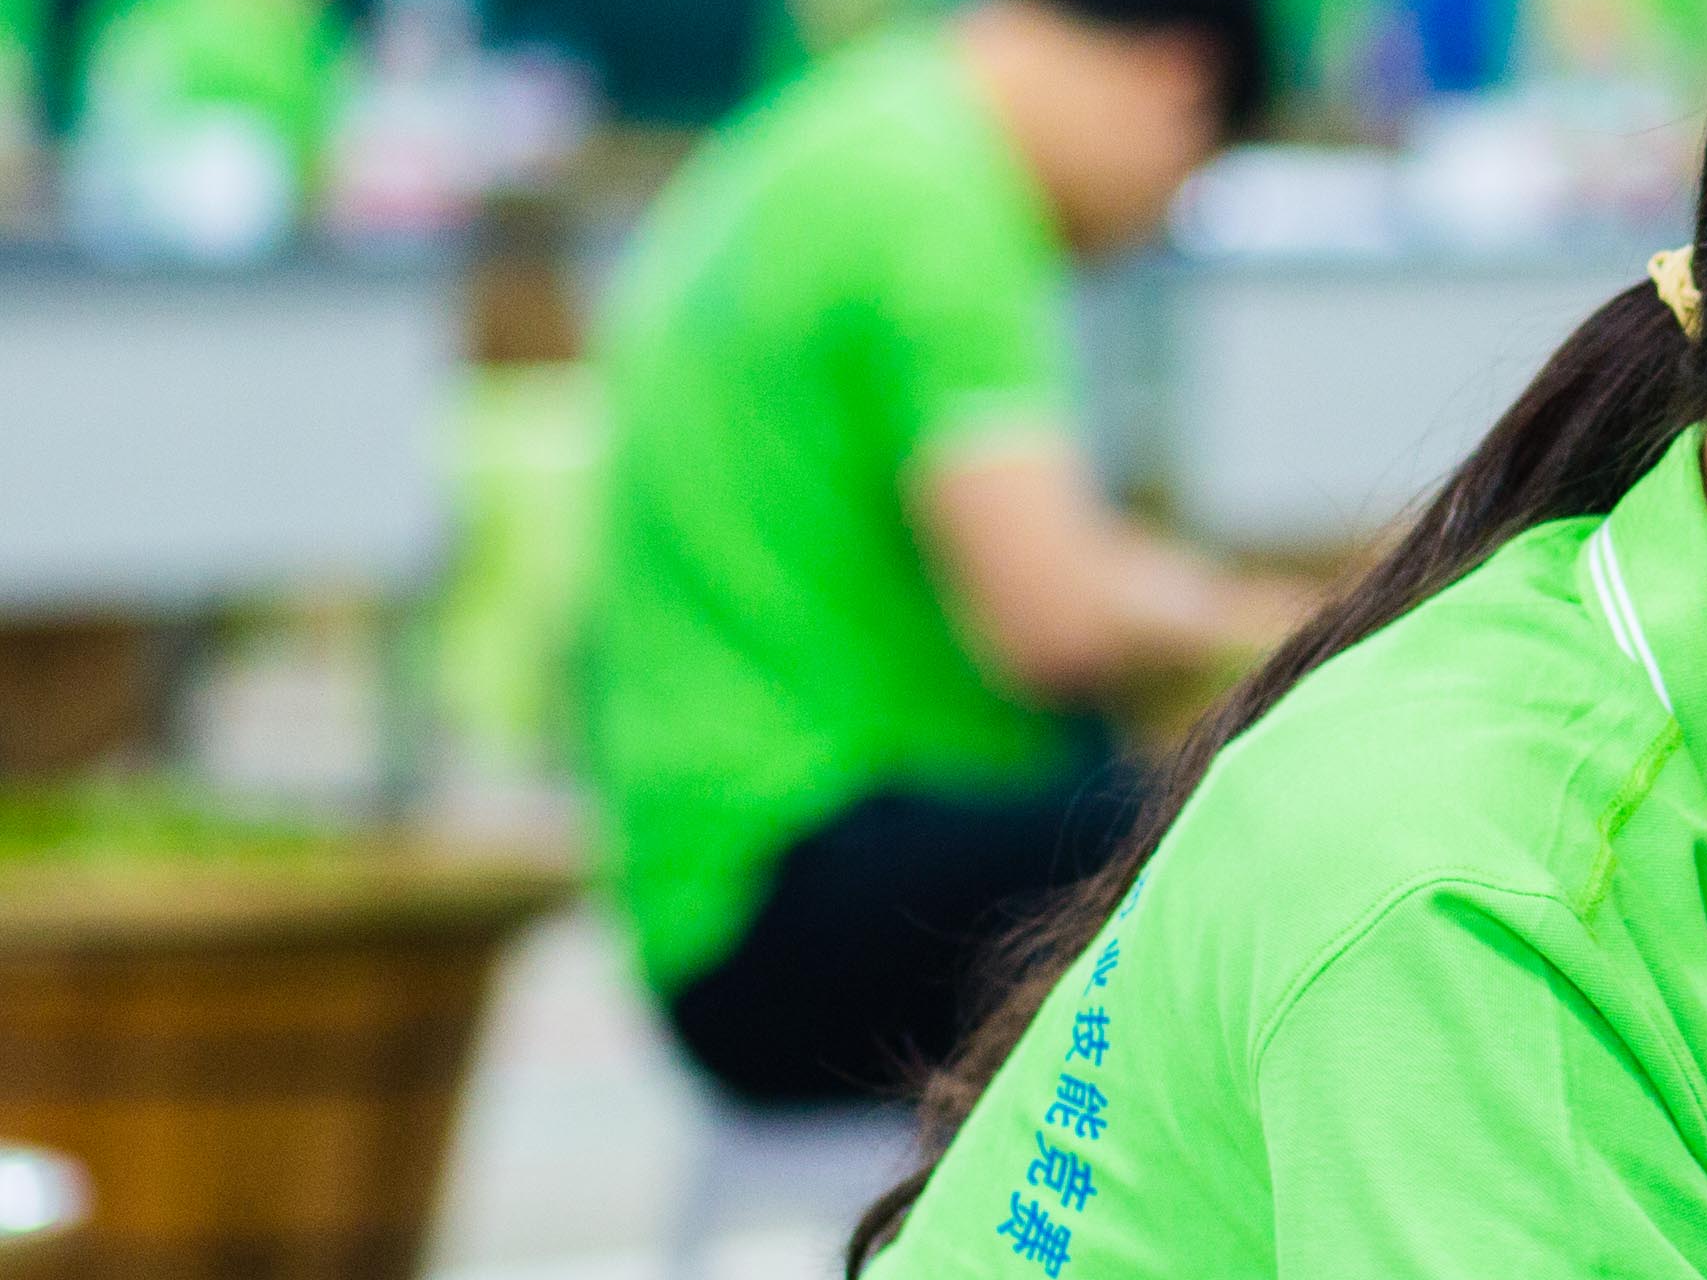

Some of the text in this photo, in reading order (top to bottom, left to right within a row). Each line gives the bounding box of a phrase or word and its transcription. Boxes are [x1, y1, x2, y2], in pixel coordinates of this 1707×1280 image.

[997, 872, 1150, 1280] 业技能竞赛
